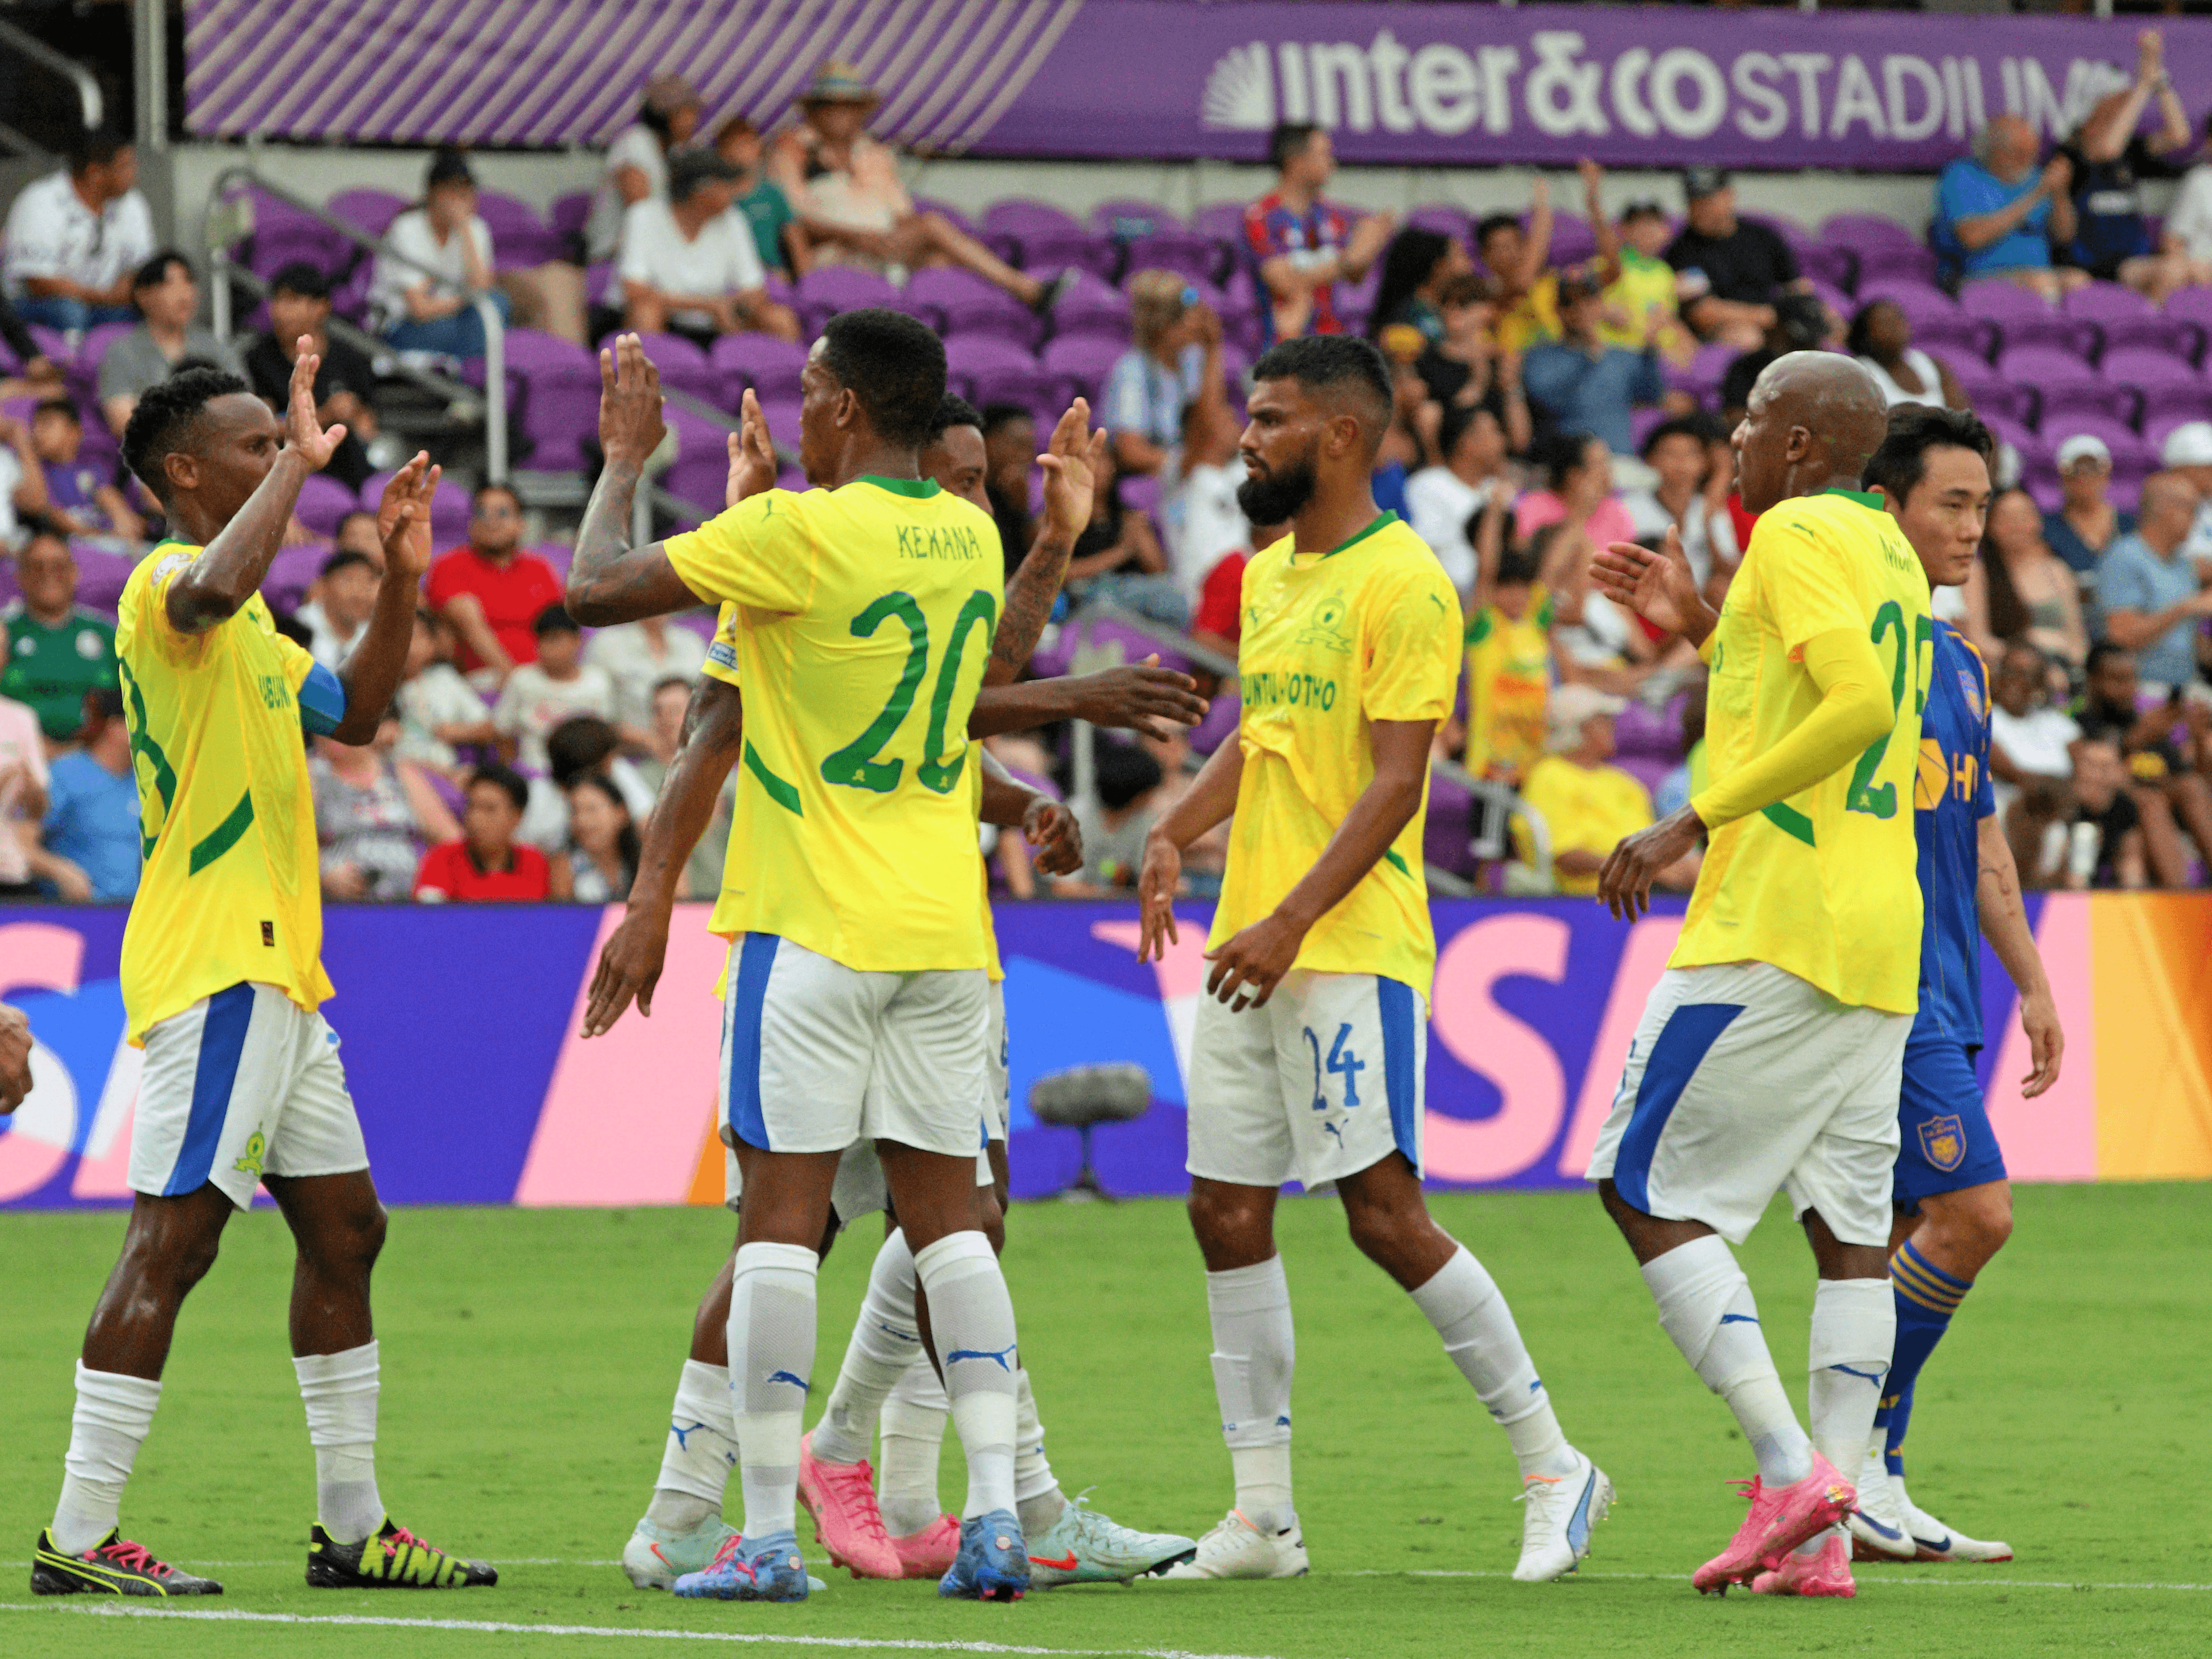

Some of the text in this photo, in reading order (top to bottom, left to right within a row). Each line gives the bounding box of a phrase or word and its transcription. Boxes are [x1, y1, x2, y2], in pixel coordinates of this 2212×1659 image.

[896, 524, 983, 560] KEKANA
[820, 589, 996, 794] 20
[1303, 1022, 1365, 1111] 14
[358, 1534, 471, 1586] KING
